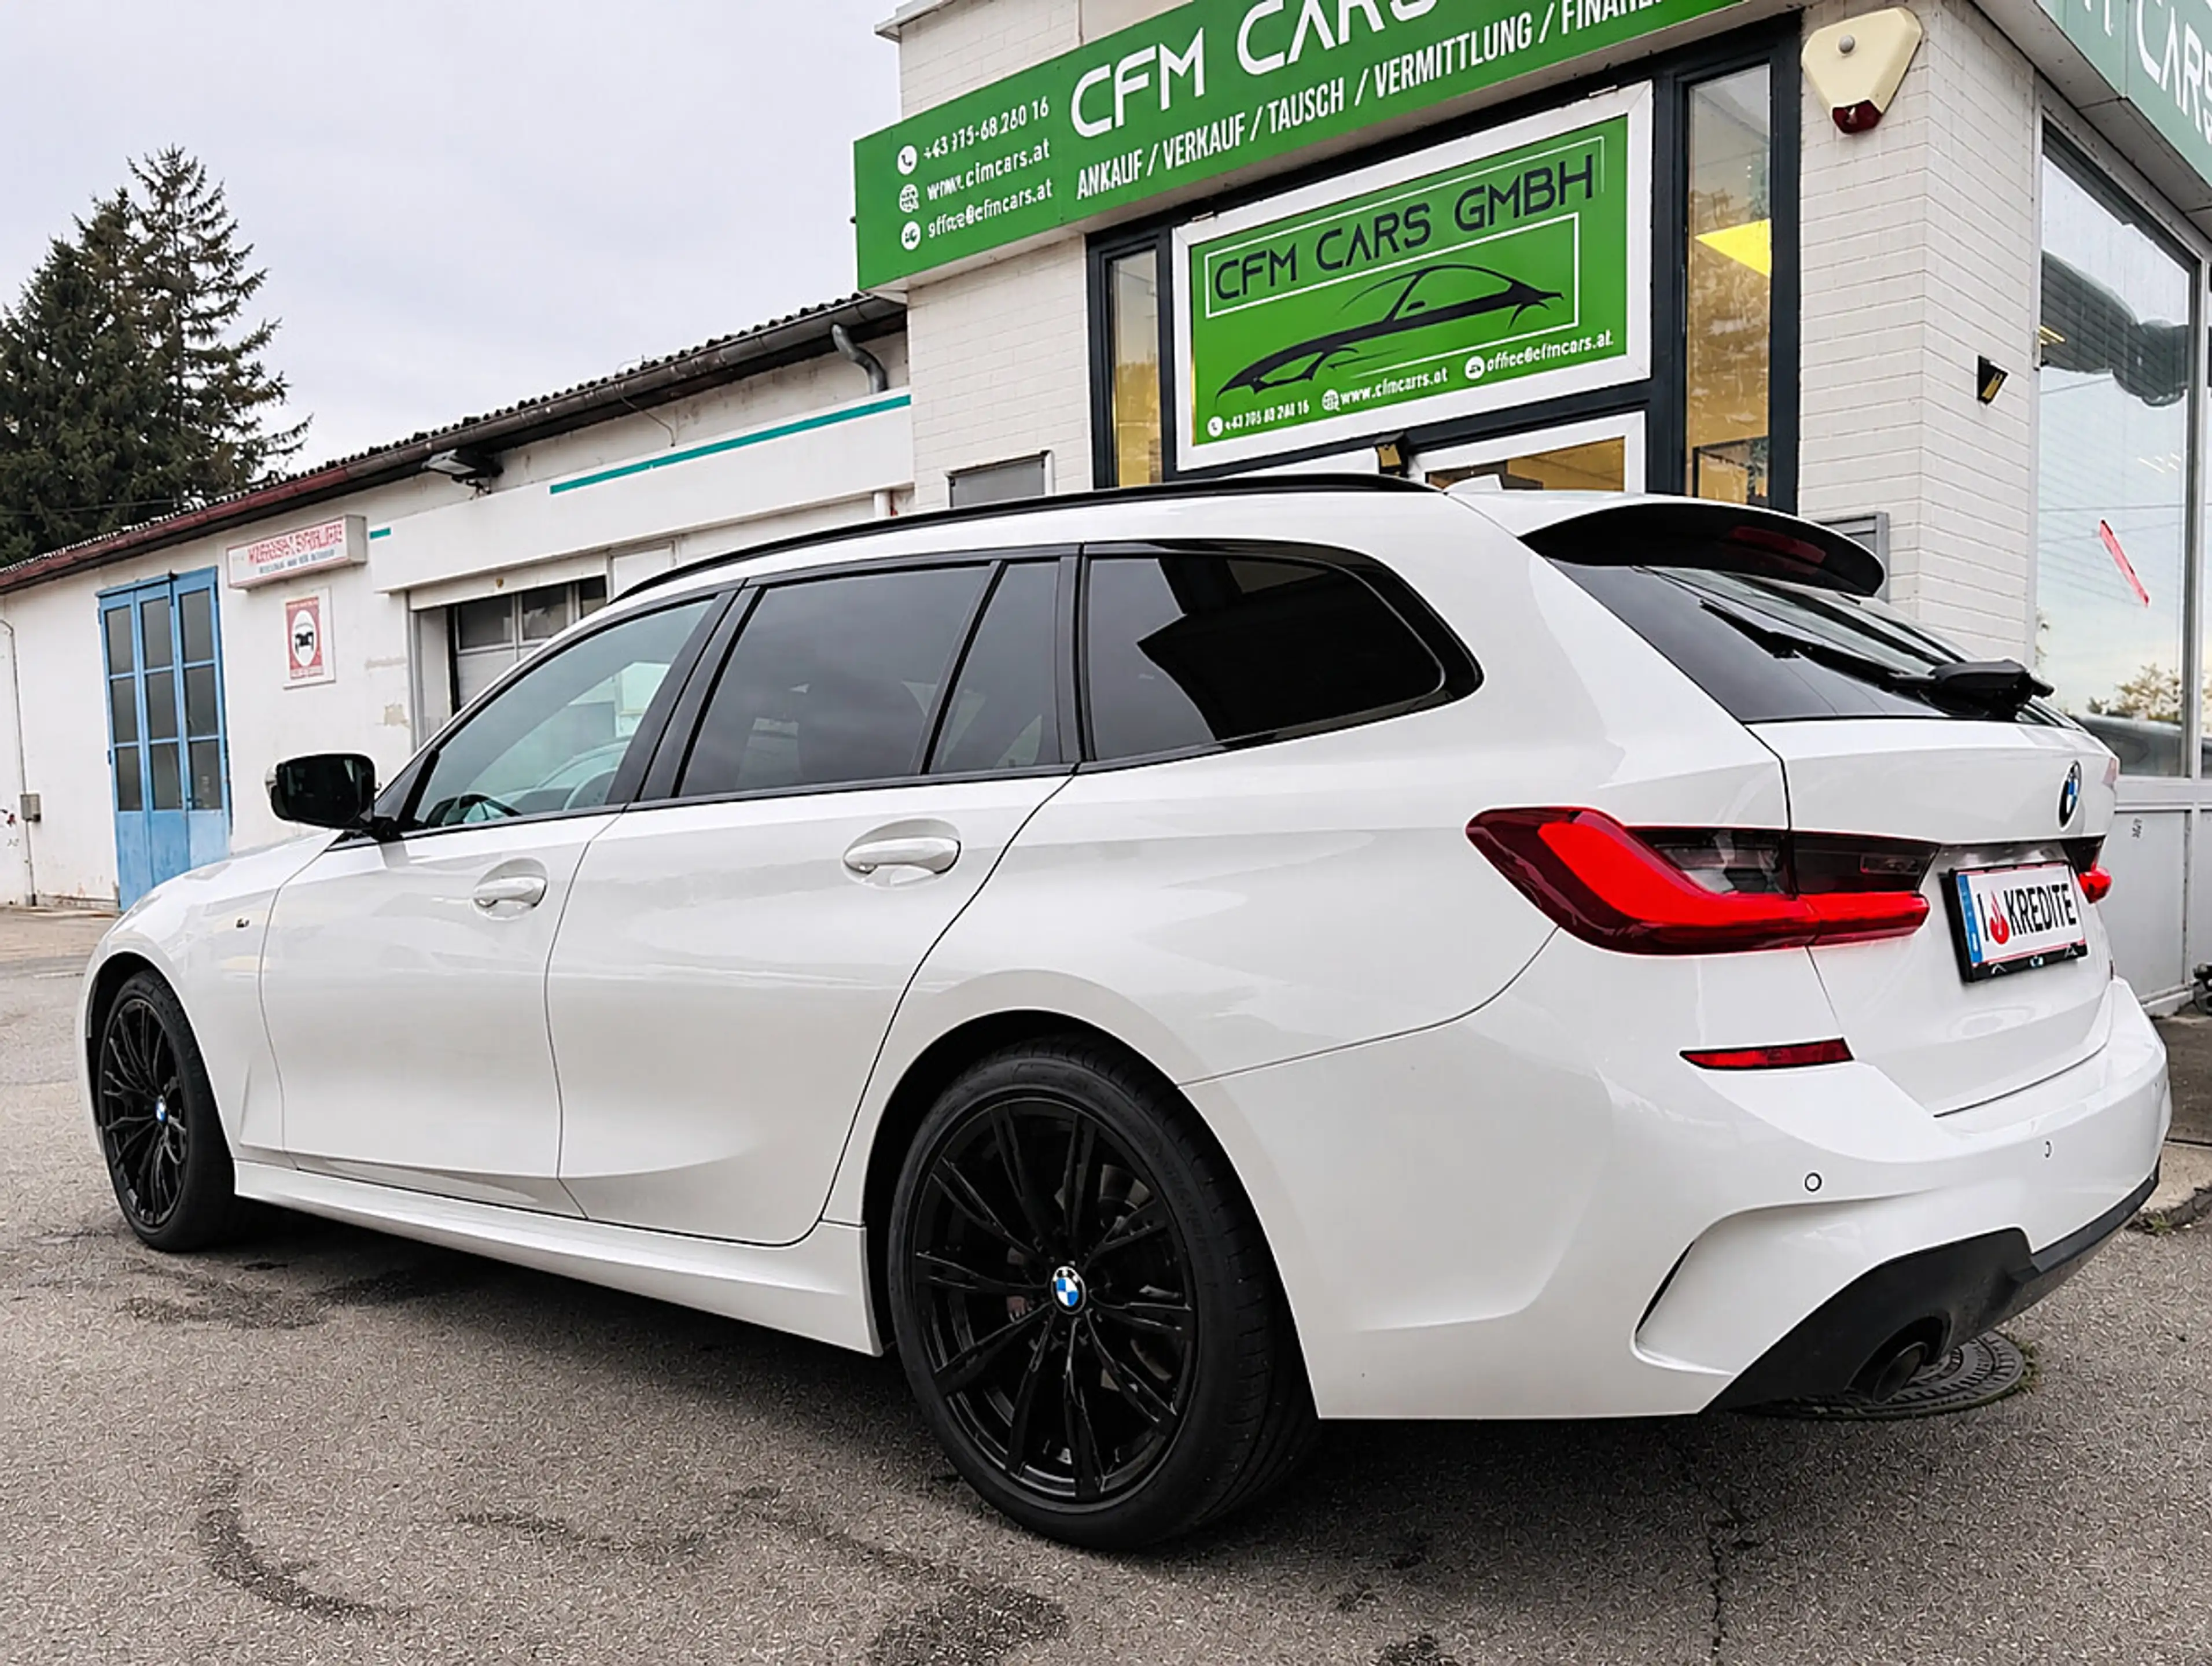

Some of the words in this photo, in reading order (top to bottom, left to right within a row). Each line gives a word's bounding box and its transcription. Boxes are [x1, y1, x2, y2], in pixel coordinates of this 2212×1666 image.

[1032, 96, 1049, 120] 16
[1071, 27, 1205, 138] CFM
[1237, 0, 1439, 75] CAR
[1077, 149, 1143, 200] ANKAUF
[1147, 143, 1158, 176] /
[1163, 112, 1245, 170] VERKAUF
[1250, 106, 1263, 141] /
[1267, 77, 1344, 134] TAUSCH
[1355, 68, 1369, 106] /
[1374, 11, 1532, 99] VERMITTLUNG
[1539, 1, 1555, 43] /
[1215, 243, 1297, 299] CFM
[1316, 202, 1431, 271] CARS
[1454, 154, 1593, 231] GMBH
[1977, 893, 1989, 942] I
[2004, 883, 2077, 937] KREDITE
